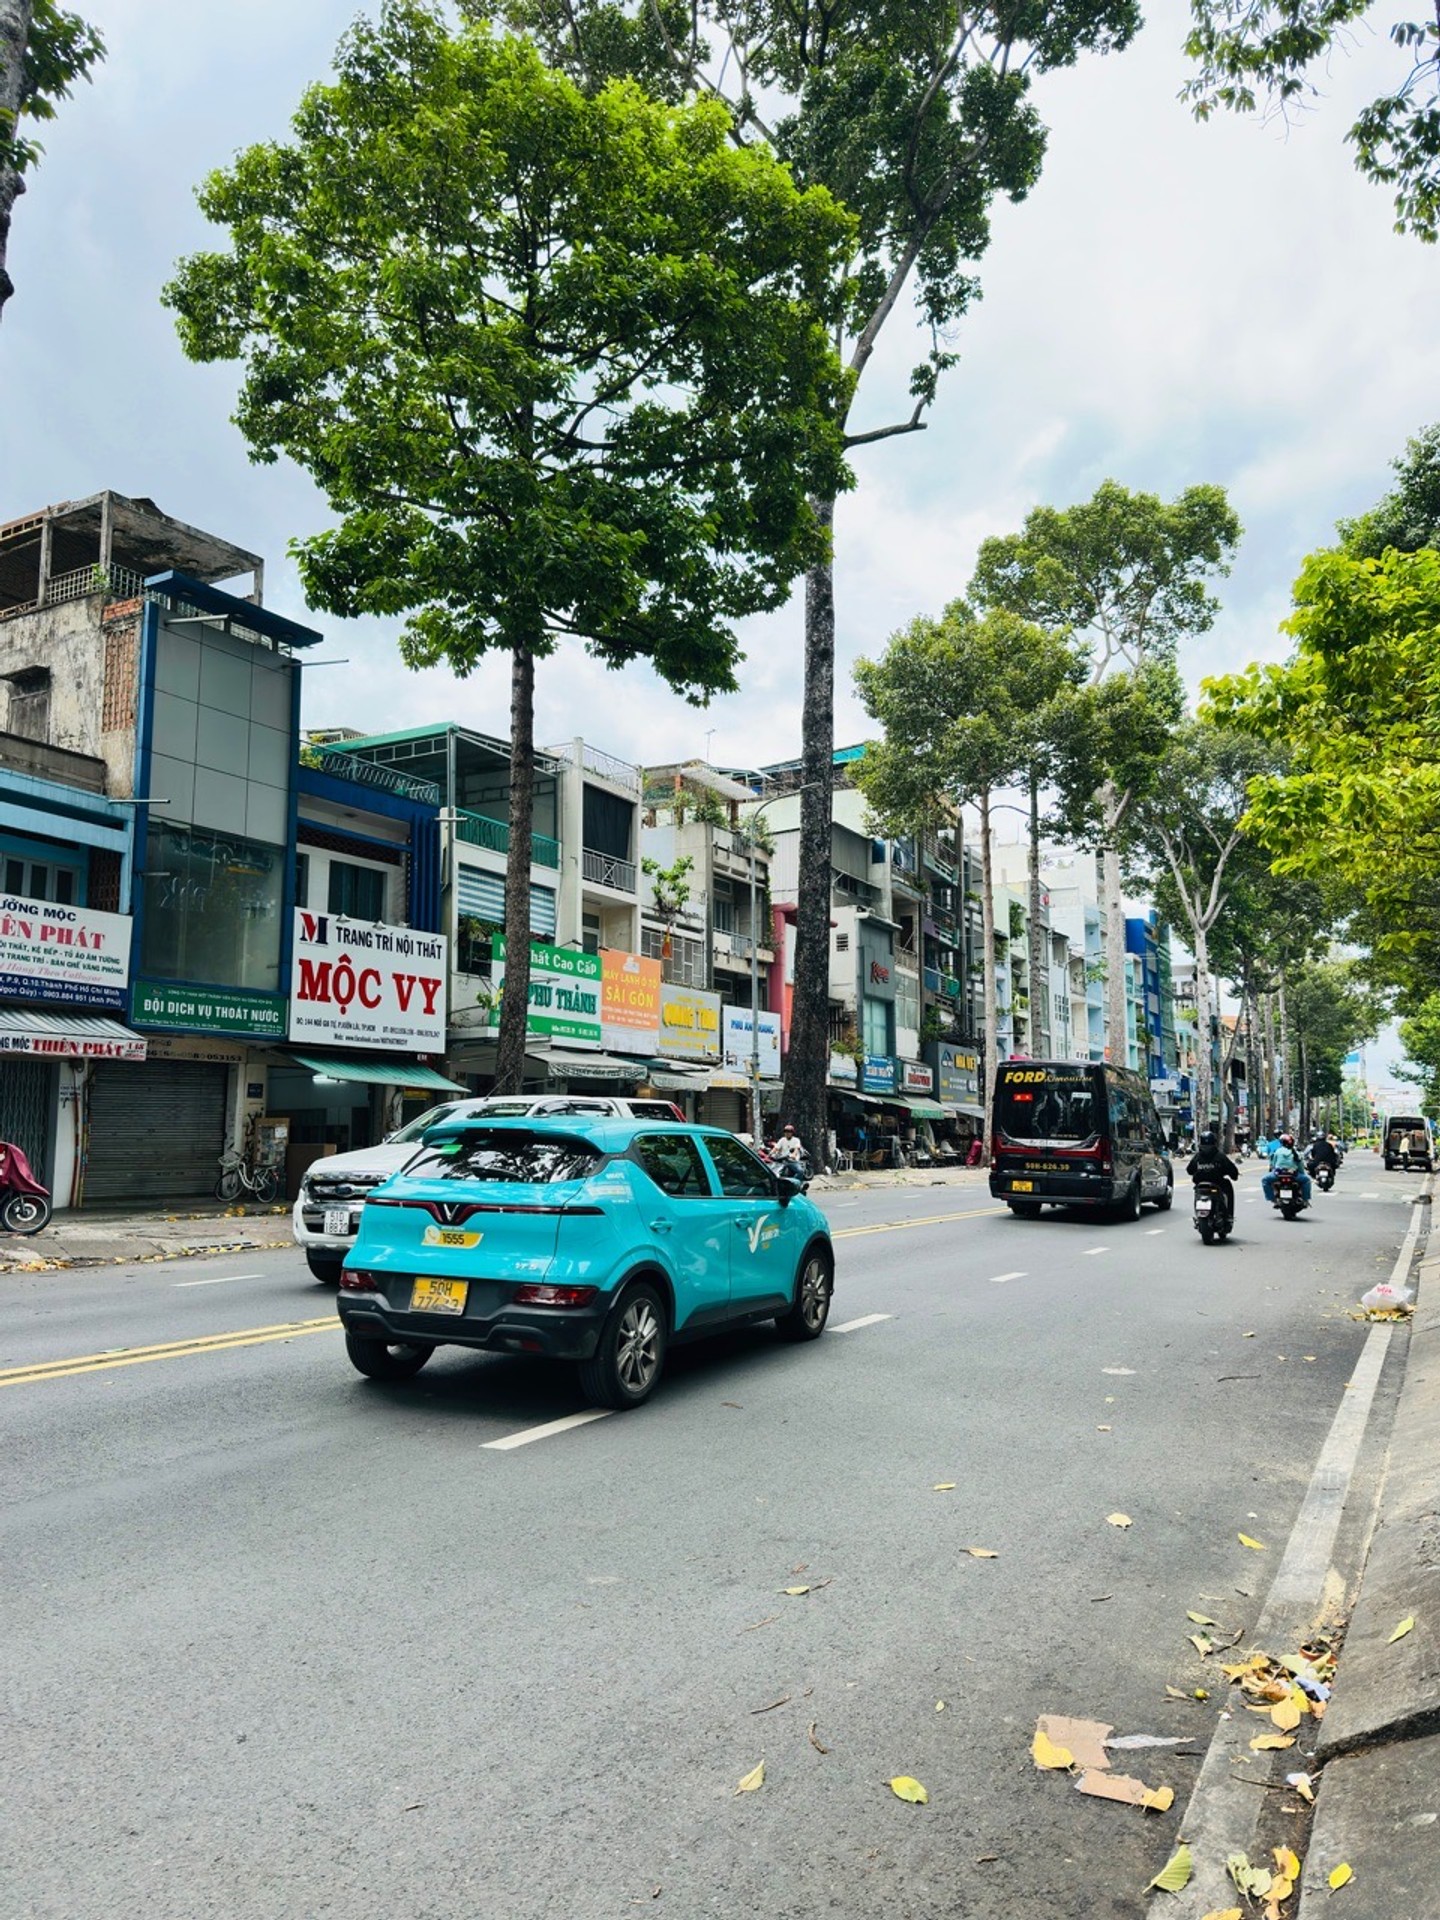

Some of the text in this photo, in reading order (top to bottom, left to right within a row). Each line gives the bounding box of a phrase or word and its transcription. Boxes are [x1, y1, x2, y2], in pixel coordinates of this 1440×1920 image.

[43, 907, 77, 922] MỘC
[40, 924, 105, 950] PHÁT
[336, 926, 443, 960] TRANG TRÍ NỘI THẤT
[553, 955, 574, 970] Cao
[577, 960, 597, 975] Cấp
[297, 953, 442, 1015] MỘC VY
[606, 984, 625, 1003] SÀI
[629, 989, 654, 1008] GÒN
[144, 998, 279, 1023] ĐỘI DỊCH VỤ THOÁT NƯỚC
[31, 1038, 79, 1054] THIÊN
[82, 1041, 125, 1056] PHÁT
[1004, 1071, 1046, 1084] FORD
[443, 1232, 465, 1245] 1555
